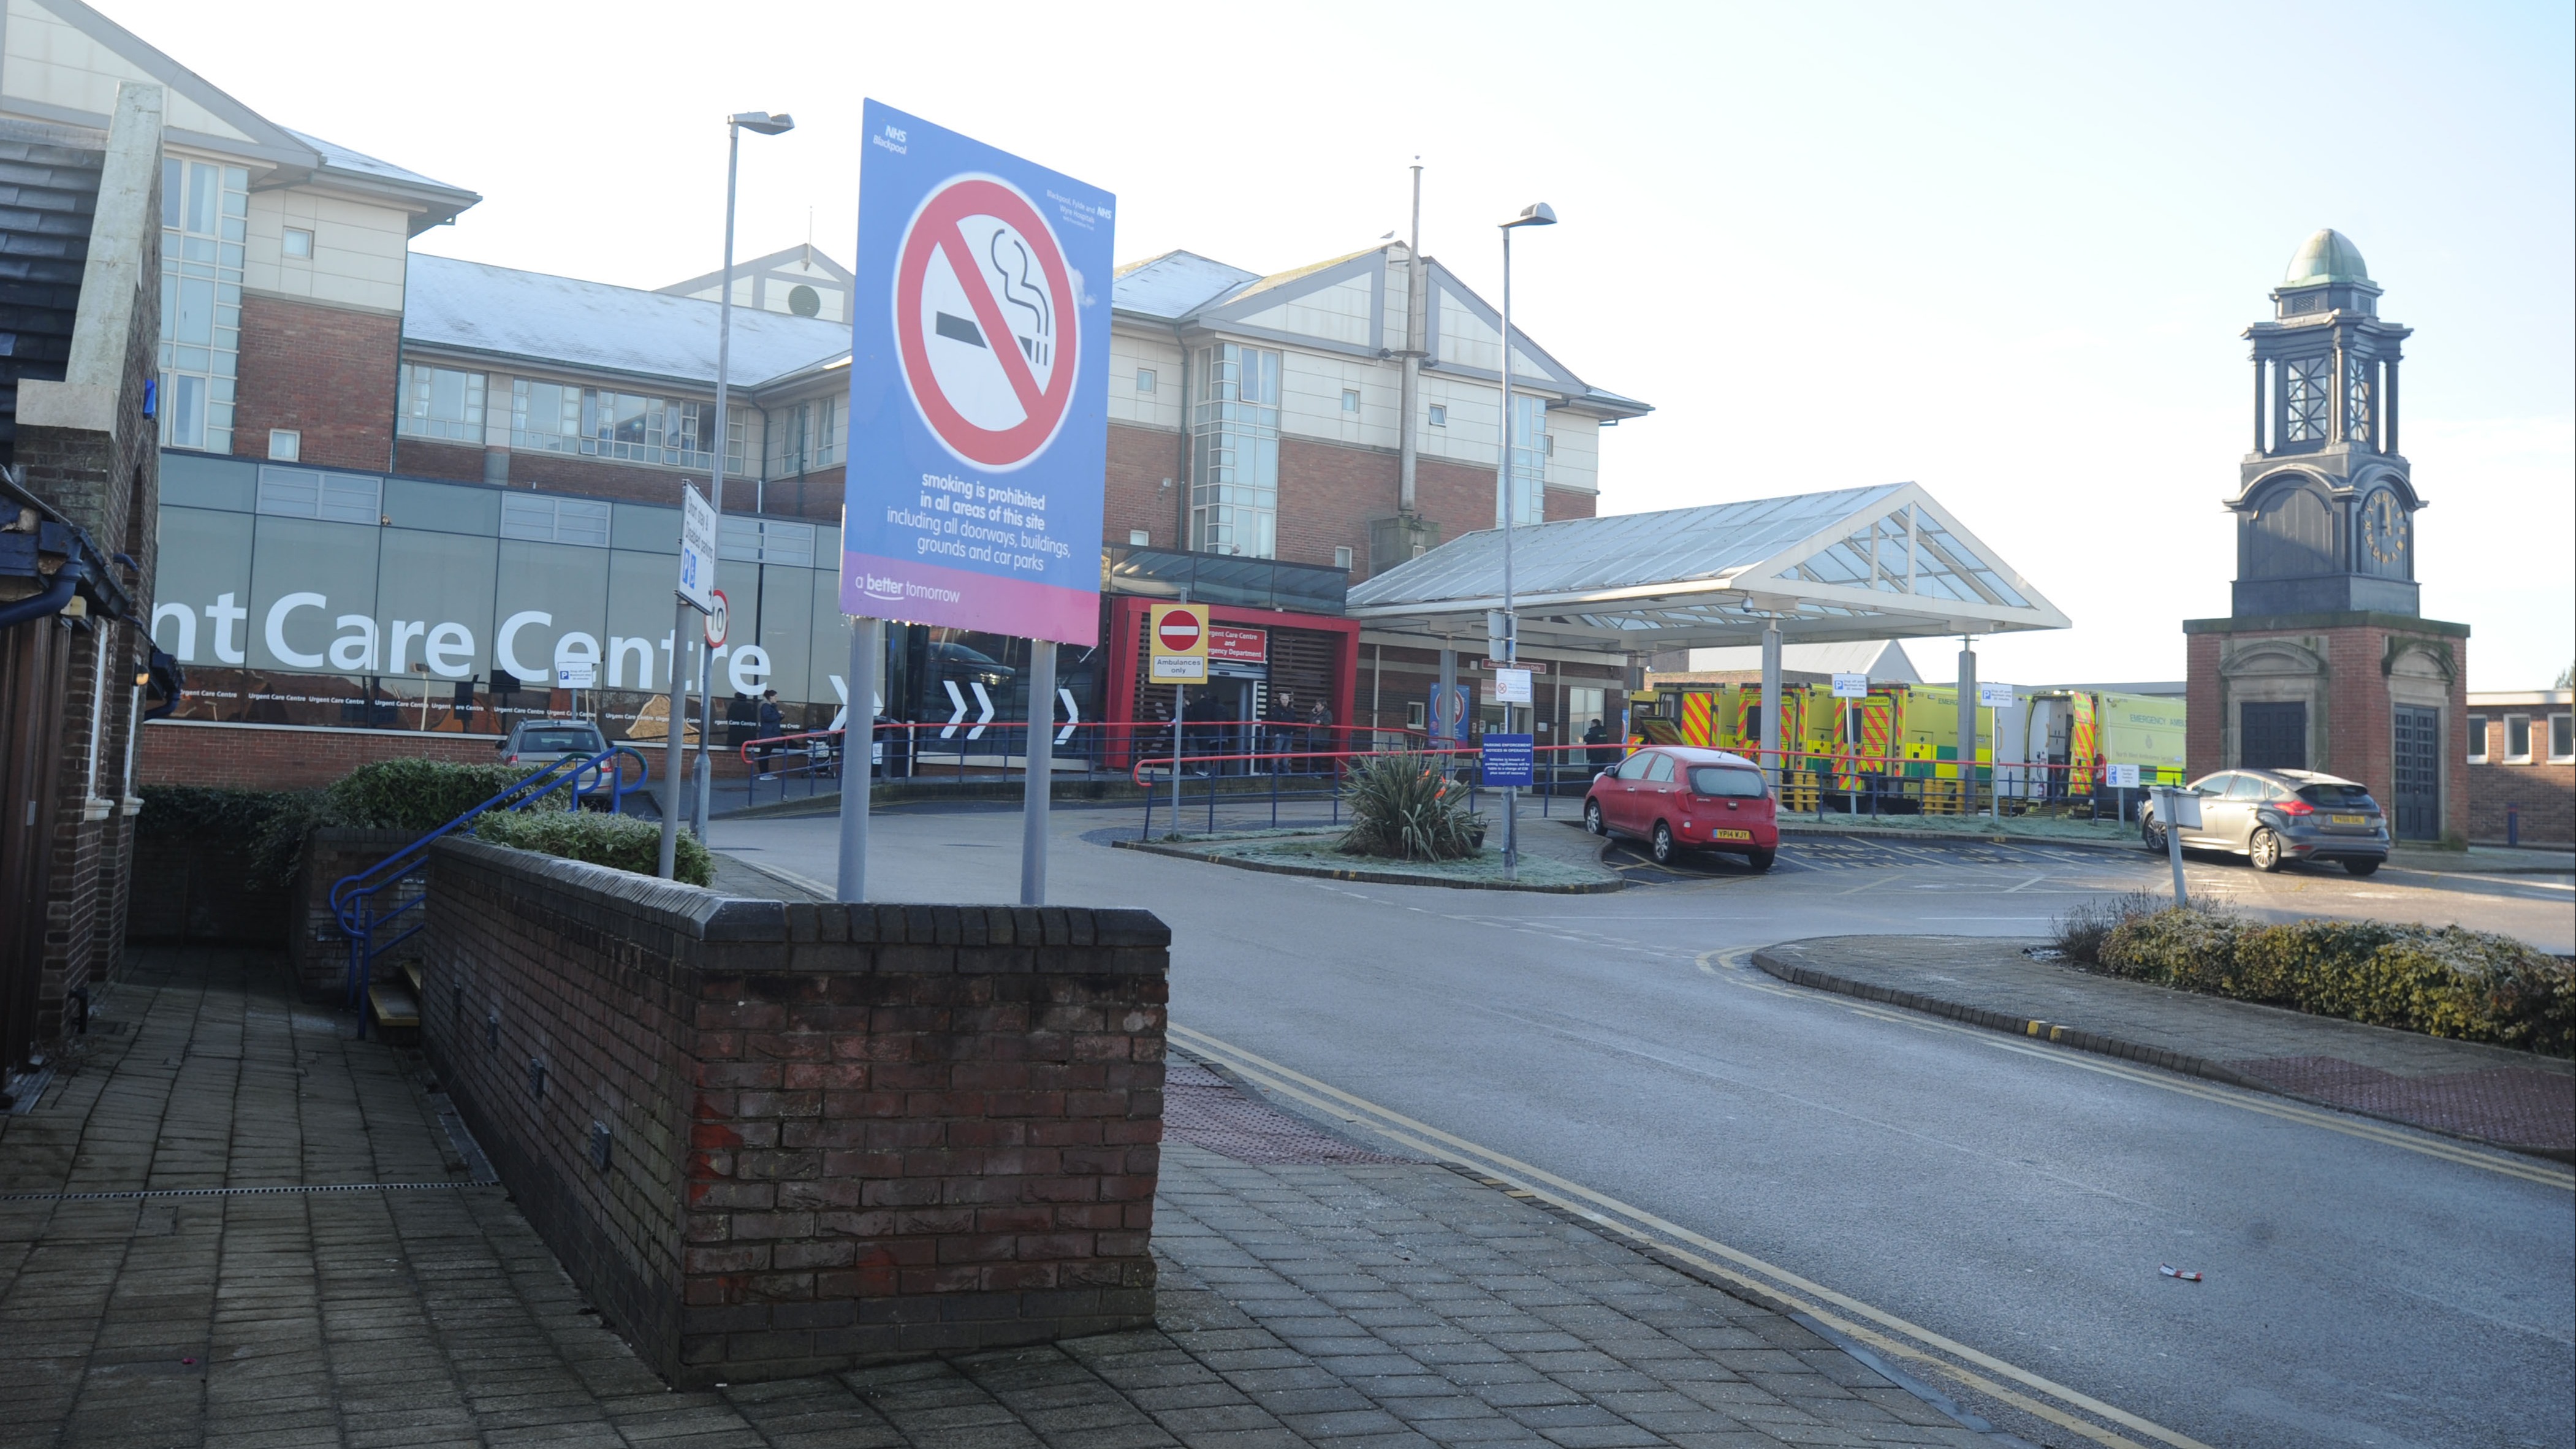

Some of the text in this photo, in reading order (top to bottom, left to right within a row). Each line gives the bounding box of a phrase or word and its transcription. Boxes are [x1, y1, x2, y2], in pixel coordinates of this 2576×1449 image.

[873, 134, 907, 154] Blackpool
[885, 124, 906, 143] NHS
[1046, 189, 1095, 214] Blackpool, Fylde and
[1059, 204, 1095, 224] Wyre Hospitals
[1097, 206, 1112, 219] NHS
[922, 473, 1045, 510] smoking is prohibited
[921, 490, 1044, 530] in all areas of this site
[686, 521, 713, 564] Disabled parking
[887, 506, 1071, 558] including all doorways, buildings,
[918, 537, 1044, 571] grounds and car parks
[855, 573, 960, 603] a better tomorrow
[712, 606, 724, 632] 10
[265, 592, 476, 677] Care
[1229, 649, 1261, 658] Department
[2130, 714, 2166, 726] EMERGENCY
